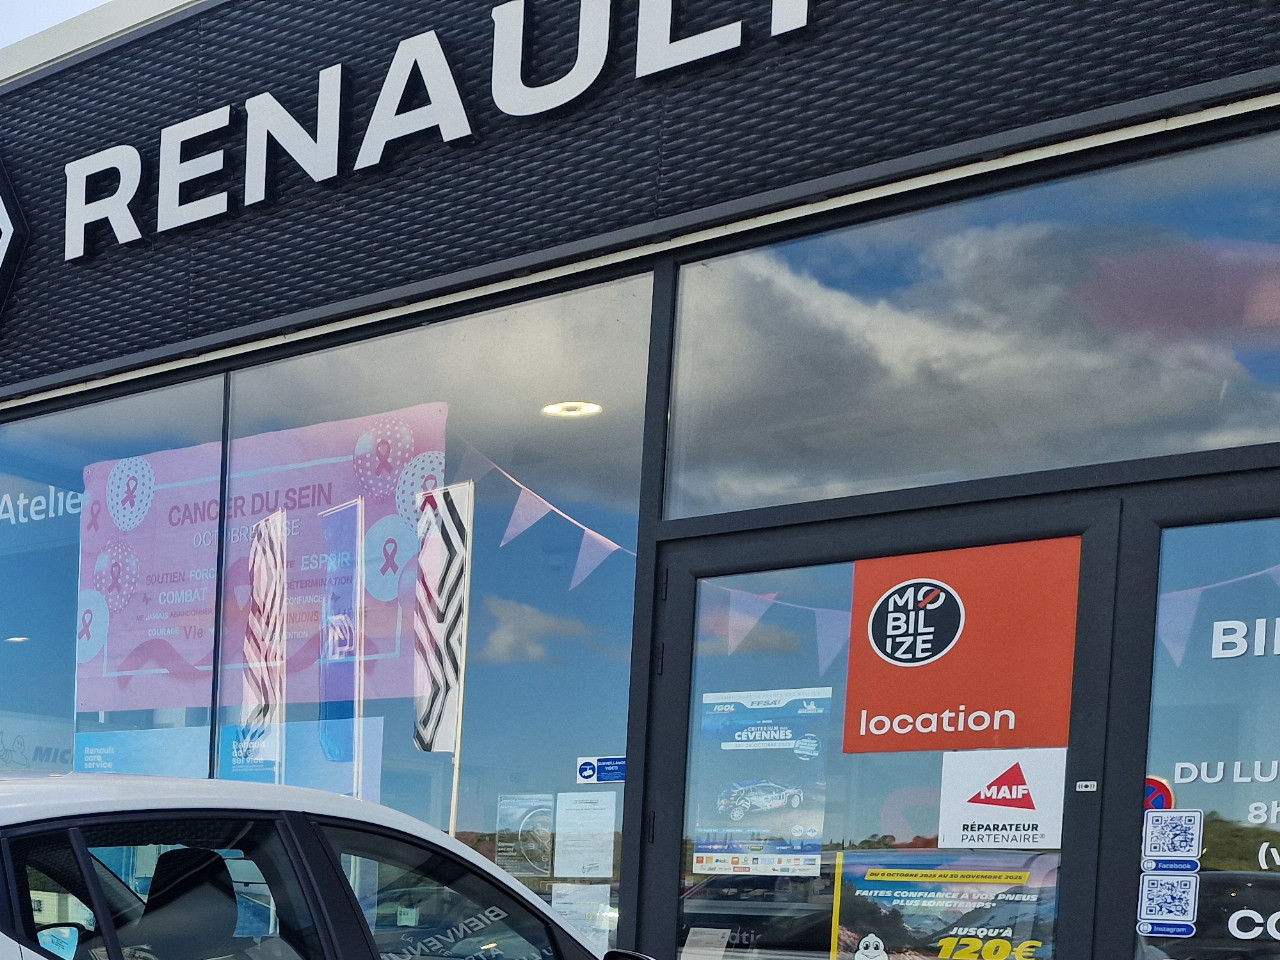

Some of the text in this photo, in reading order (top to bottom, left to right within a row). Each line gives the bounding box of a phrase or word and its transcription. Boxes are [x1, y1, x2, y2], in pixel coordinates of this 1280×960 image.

[64, 0, 808, 261] RENAUL
[250, 490, 280, 515] DU
[283, 482, 333, 510] SEIN
[301, 551, 352, 572] ESPOIR
[146, 568, 217, 586] SOUTIEN FORC
[158, 587, 208, 605] COMBAT
[148, 625, 204, 640] COURAGE Vie
[1211, 617, 1280, 659] BI
[713, 704, 735, 712] IGOL
[859, 705, 1016, 736] location
[734, 729, 792, 740] CÉVENNES
[84, 746, 115, 755] Renault
[232, 740, 266, 749] Renault
[1174, 762, 1225, 784] DU
[980, 785, 1029, 800] MAIF
[962, 821, 1039, 832] RÉPARATEUR
[854, 889, 893, 897] FAITES
[893, 890, 960, 899] CONFIANCE
[997, 893, 1038, 902] PNEUS
[949, 926, 1013, 938] JUSQU'À
[1153, 925, 1187, 934] Instagram
